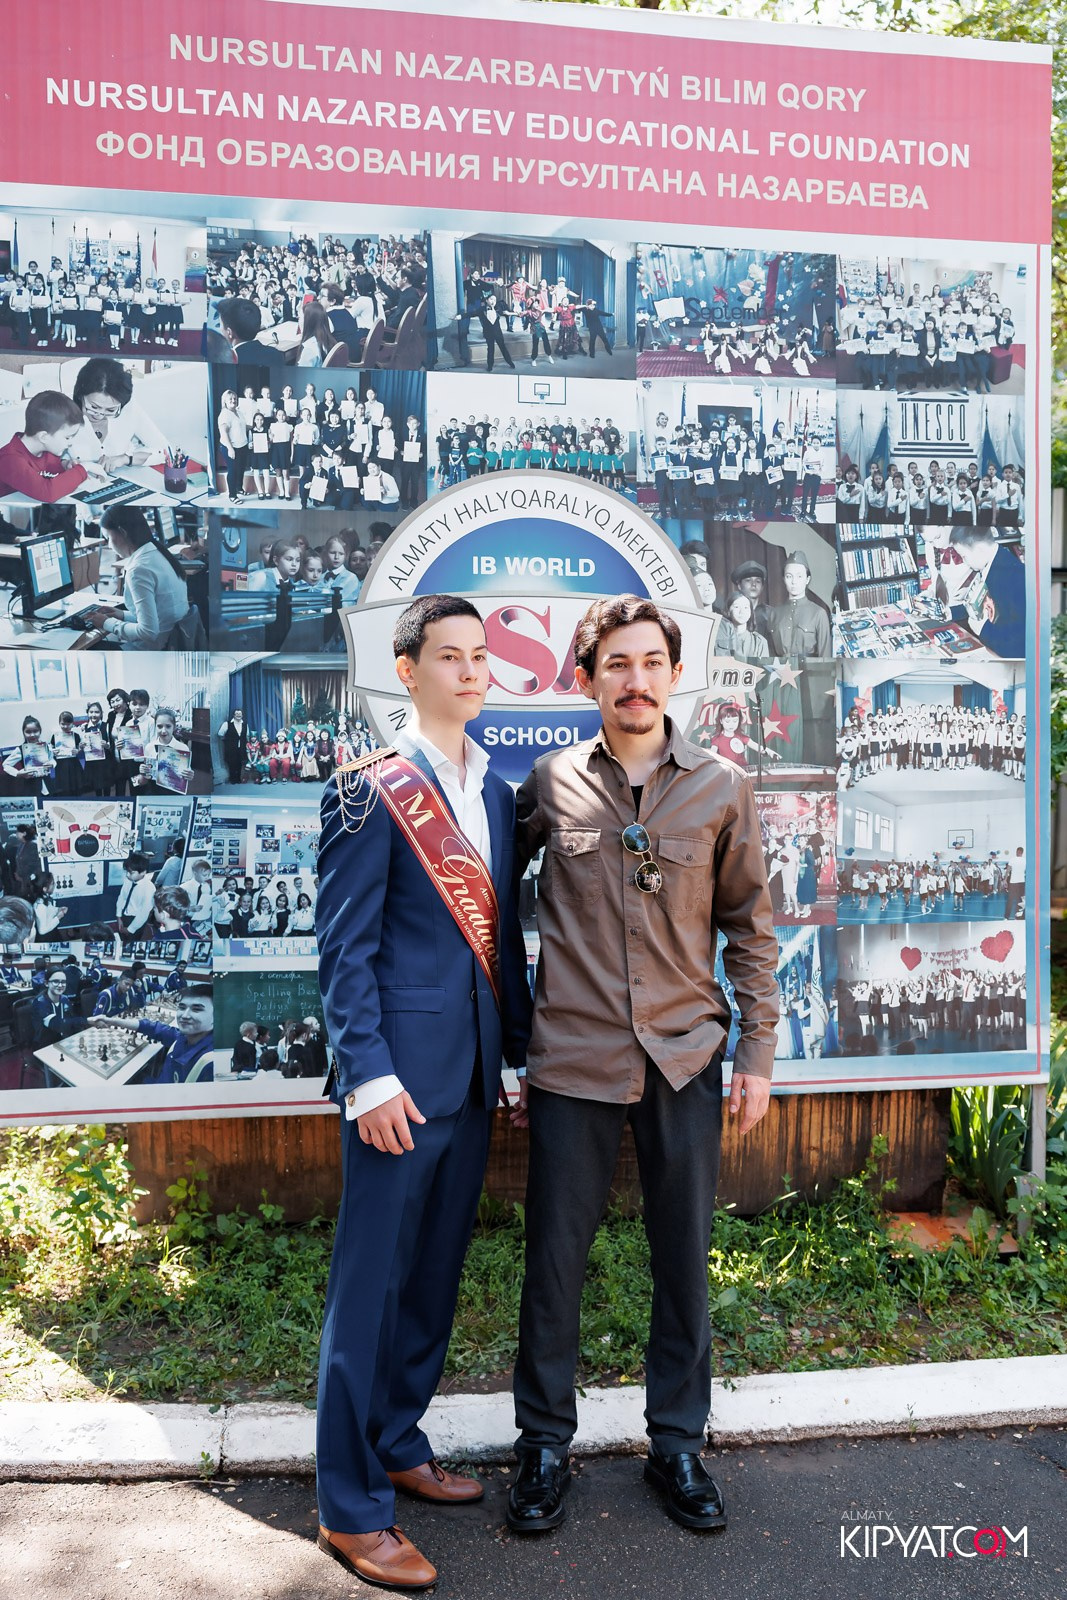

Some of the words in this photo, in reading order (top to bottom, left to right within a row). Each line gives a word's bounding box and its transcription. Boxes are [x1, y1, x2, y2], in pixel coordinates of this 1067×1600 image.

[170, 33, 382, 76] NURSULTAN
[395, 50, 669, 99] NAZARBAEVTYŃ
[681, 75, 767, 106] BILIM
[777, 82, 867, 113] QORY
[46, 77, 264, 120] NURSULTAN
[277, 94, 516, 136] NAZARBAYEV
[526, 112, 760, 156] EDUCATIONAL
[769, 131, 970, 169] FOUNDATION
[96, 130, 206, 169] ФОНД
[216, 138, 480, 181] ОБРАЗОВАНИЯ
[492, 156, 708, 197] НУРСУЛТАНА
[717, 172, 929, 210] НАЗАРБАЕВА
[684, 297, 787, 322] September
[901, 403, 966, 441] UNESCO
[388, 514, 452, 591] ALMATY
[454, 488, 613, 531] HALYQARALYQ
[612, 520, 678, 598] MEKTEBI
[472, 556, 497, 575] IB
[504, 556, 596, 578] WORLD
[483, 726, 582, 747] SCHOOL
[380, 762, 412, 795] 11
[398, 788, 437, 832] M
[463, 924, 478, 943] school
[246, 984, 292, 1004] Spelling
[297, 984, 317, 997] Bee
